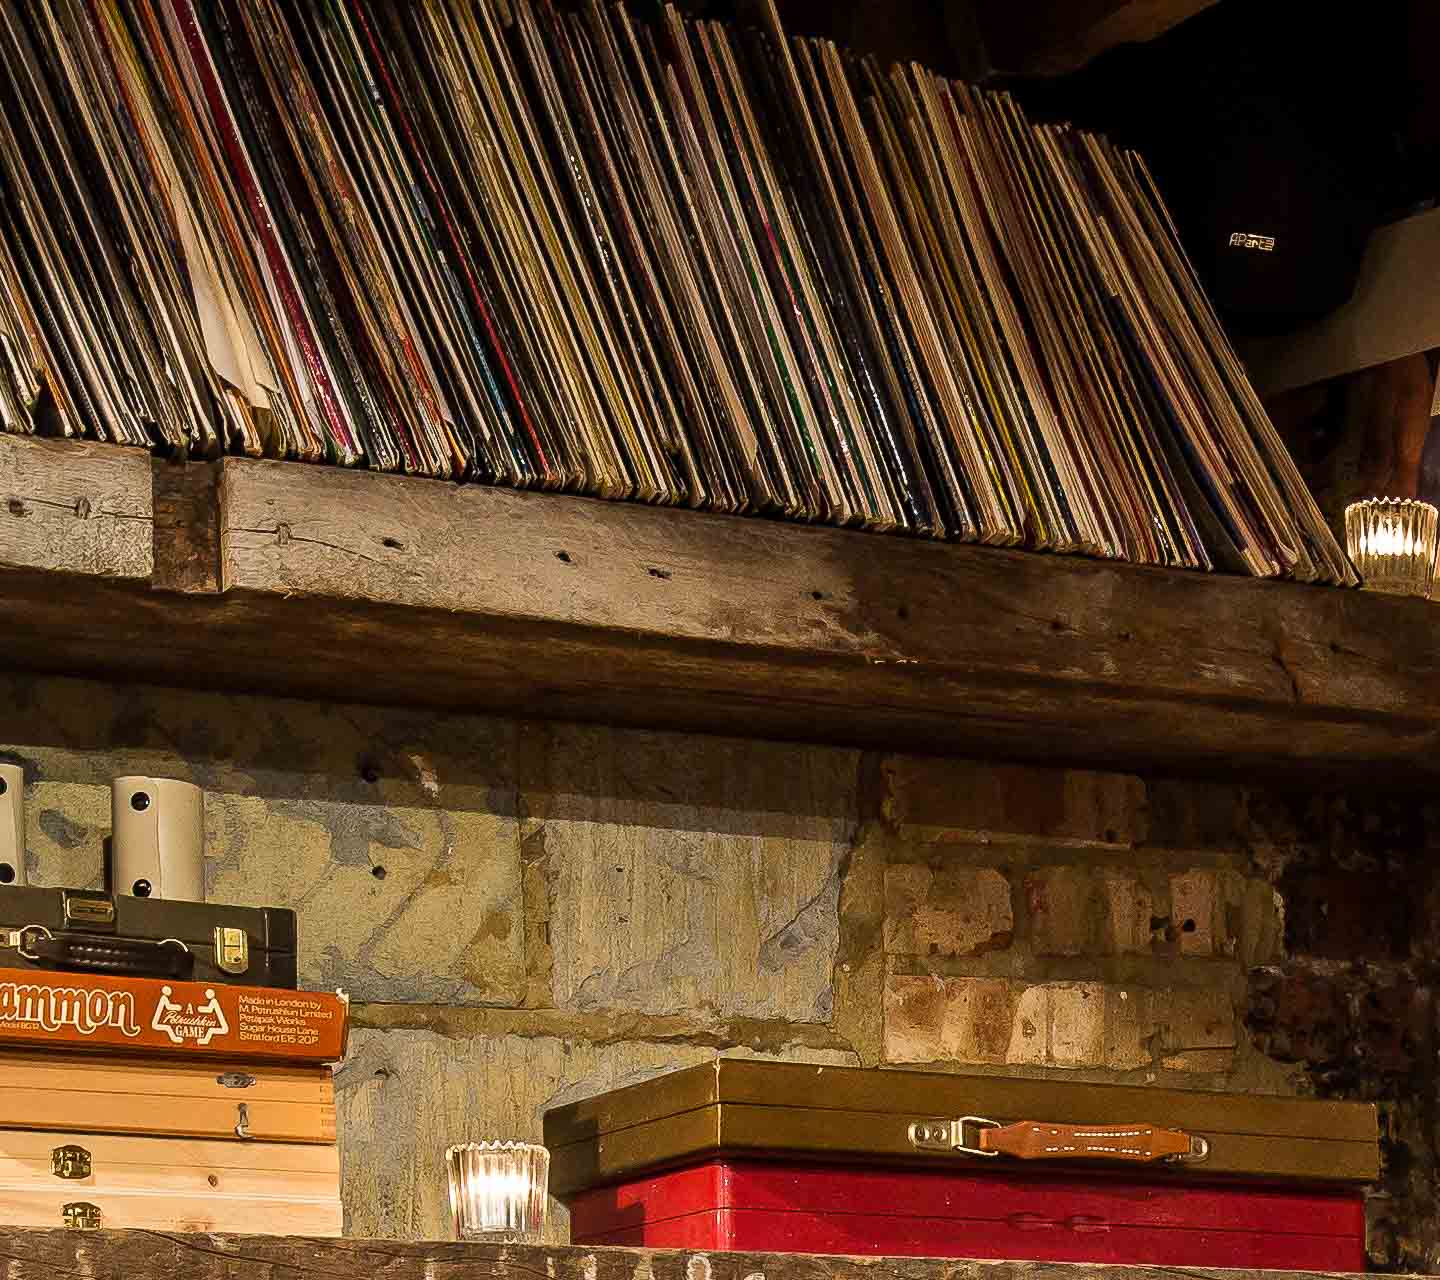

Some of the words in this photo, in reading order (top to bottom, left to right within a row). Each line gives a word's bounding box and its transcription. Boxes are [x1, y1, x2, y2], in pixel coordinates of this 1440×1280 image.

[185, 1003, 194, 1015] A
[239, 996, 266, 1005] Made
[275, 998, 309, 1008] London
[310, 1000, 322, 1010] by
[175, 1026, 206, 1038] GAME
[239, 1022, 265, 1033] Sugar
[266, 1024, 297, 1034] House
